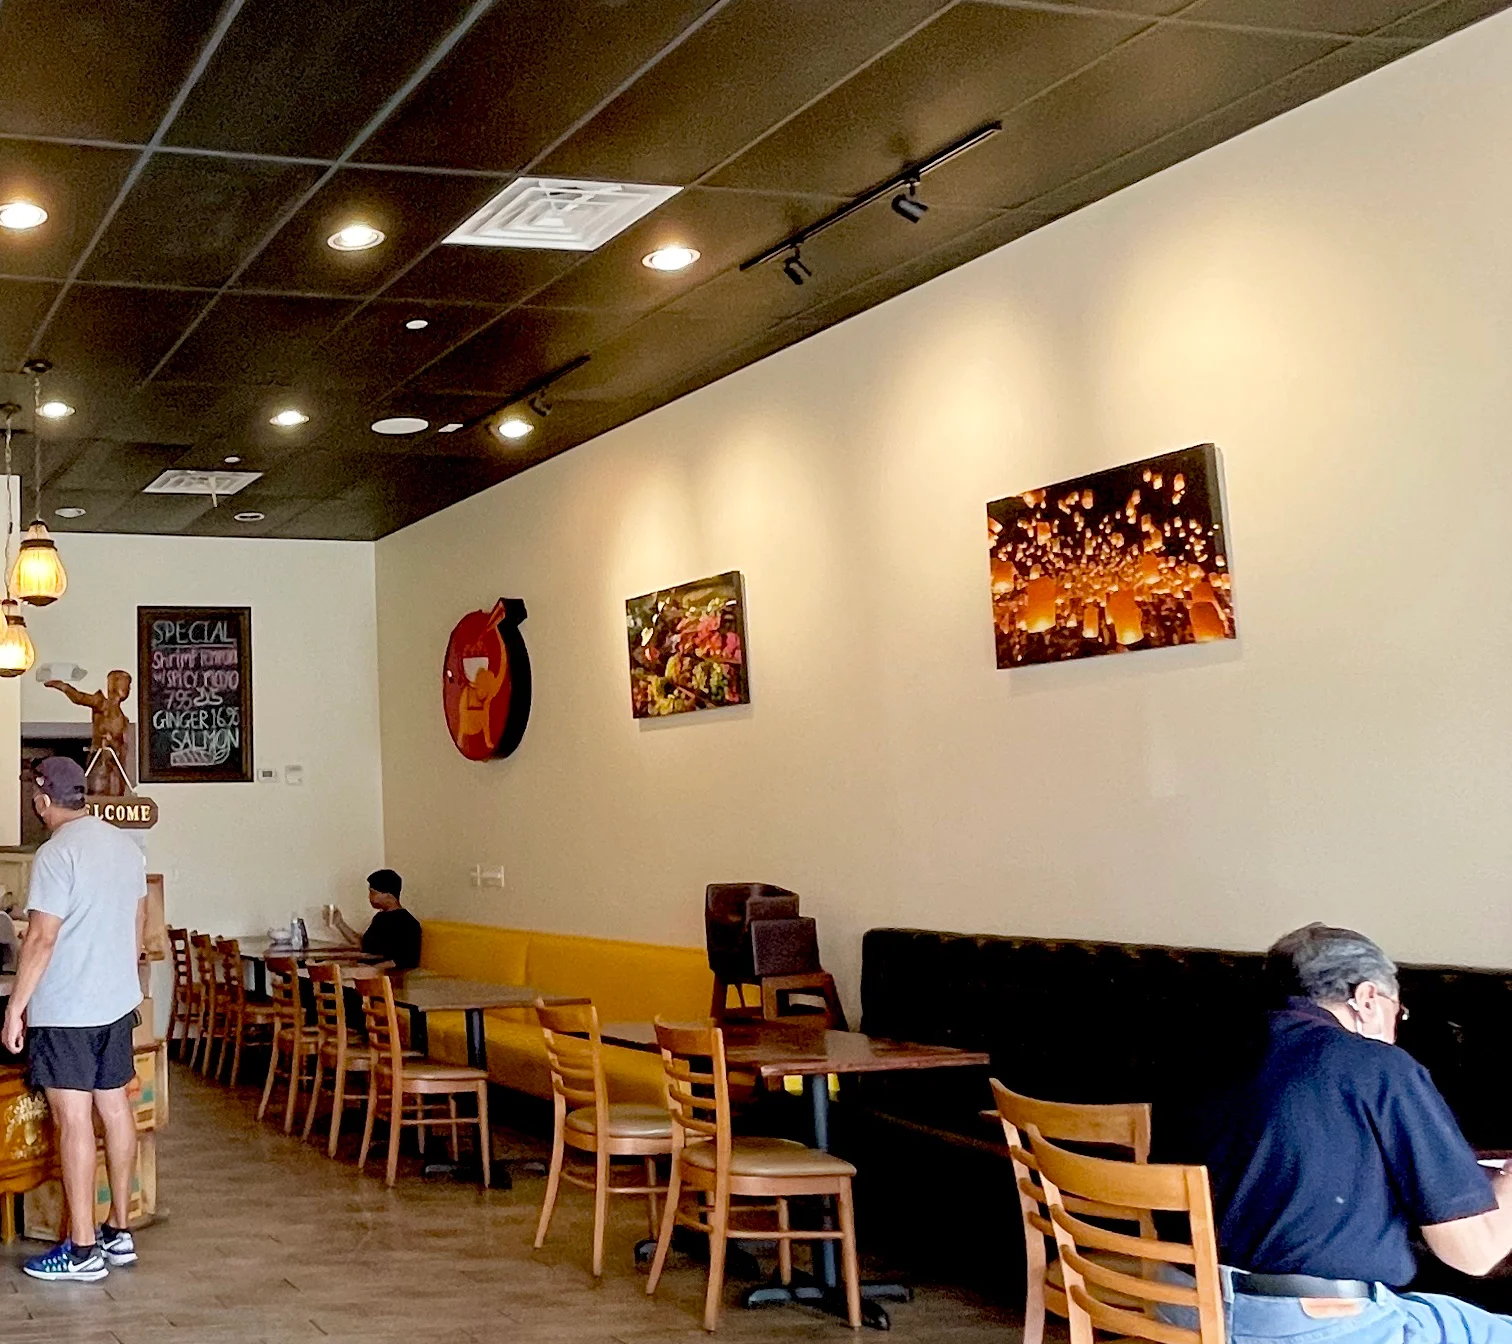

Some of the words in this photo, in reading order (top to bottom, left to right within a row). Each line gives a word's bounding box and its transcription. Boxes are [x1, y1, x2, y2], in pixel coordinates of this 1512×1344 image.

[152, 620, 234, 644] SPECIAL
[152, 710, 209, 730] GINGER
[171, 728, 239, 752] SALMON
[85, 804, 151, 821] LCOME
